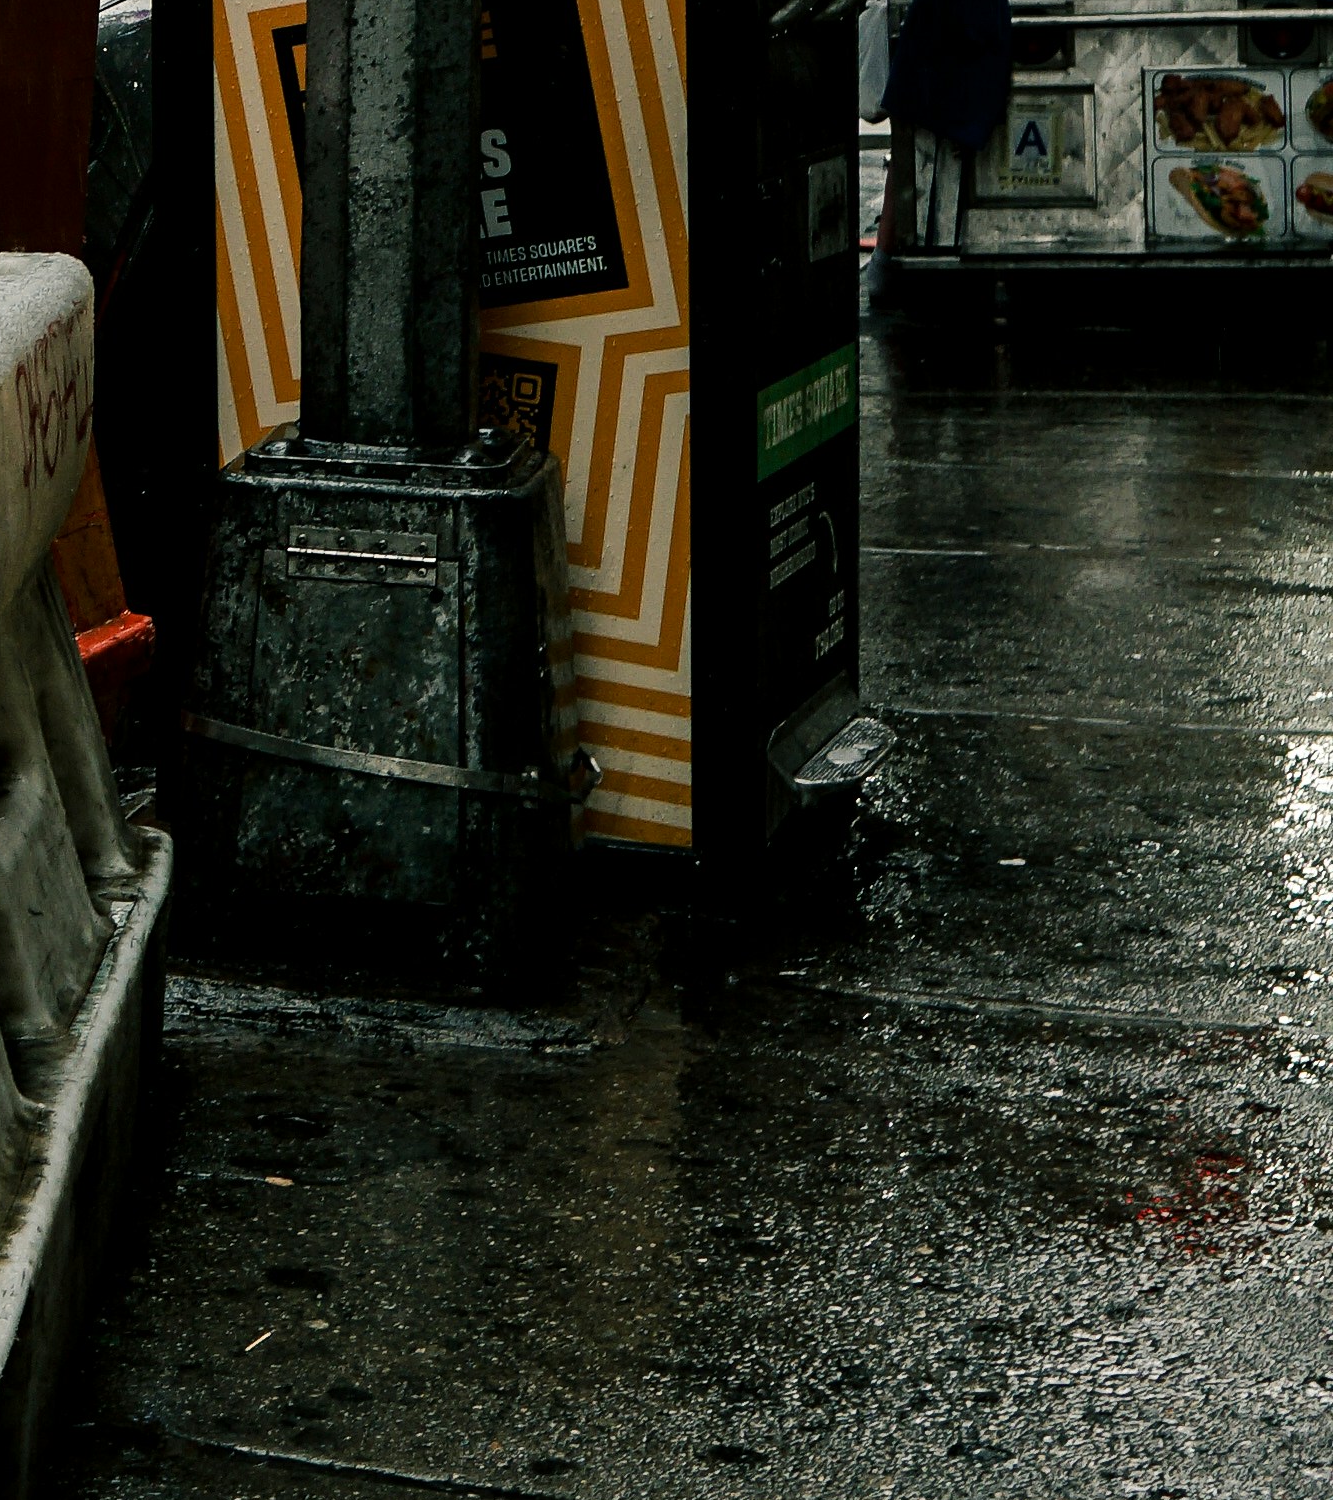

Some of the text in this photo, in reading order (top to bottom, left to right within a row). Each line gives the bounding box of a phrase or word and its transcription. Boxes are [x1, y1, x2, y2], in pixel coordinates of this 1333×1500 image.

[1015, 120, 1047, 156] A
[486, 235, 598, 265] TIMES SQUARE'S
[495, 255, 609, 287] ENTERTAINMENT.
[805, 363, 850, 426] SQUARE
